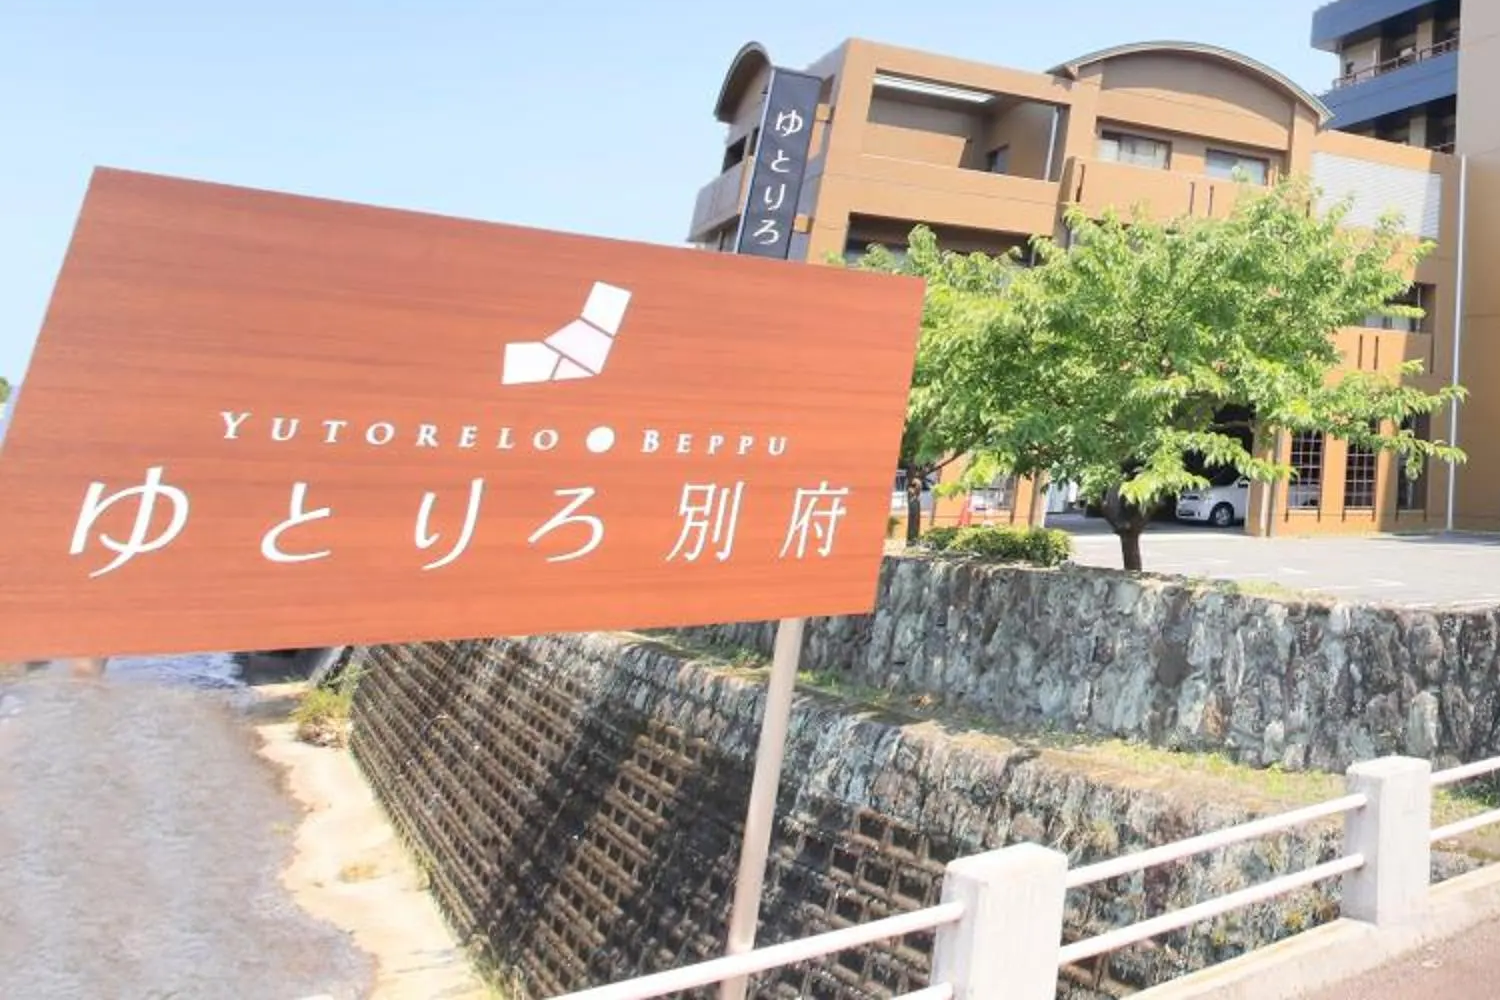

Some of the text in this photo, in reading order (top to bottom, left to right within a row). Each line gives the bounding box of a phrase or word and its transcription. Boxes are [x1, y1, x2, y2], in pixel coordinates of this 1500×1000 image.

[752, 108, 803, 245] ゆとりろ
[221, 411, 789, 457] YUTORELO BEPPU
[69, 465, 849, 578] ゆとりろ別府
